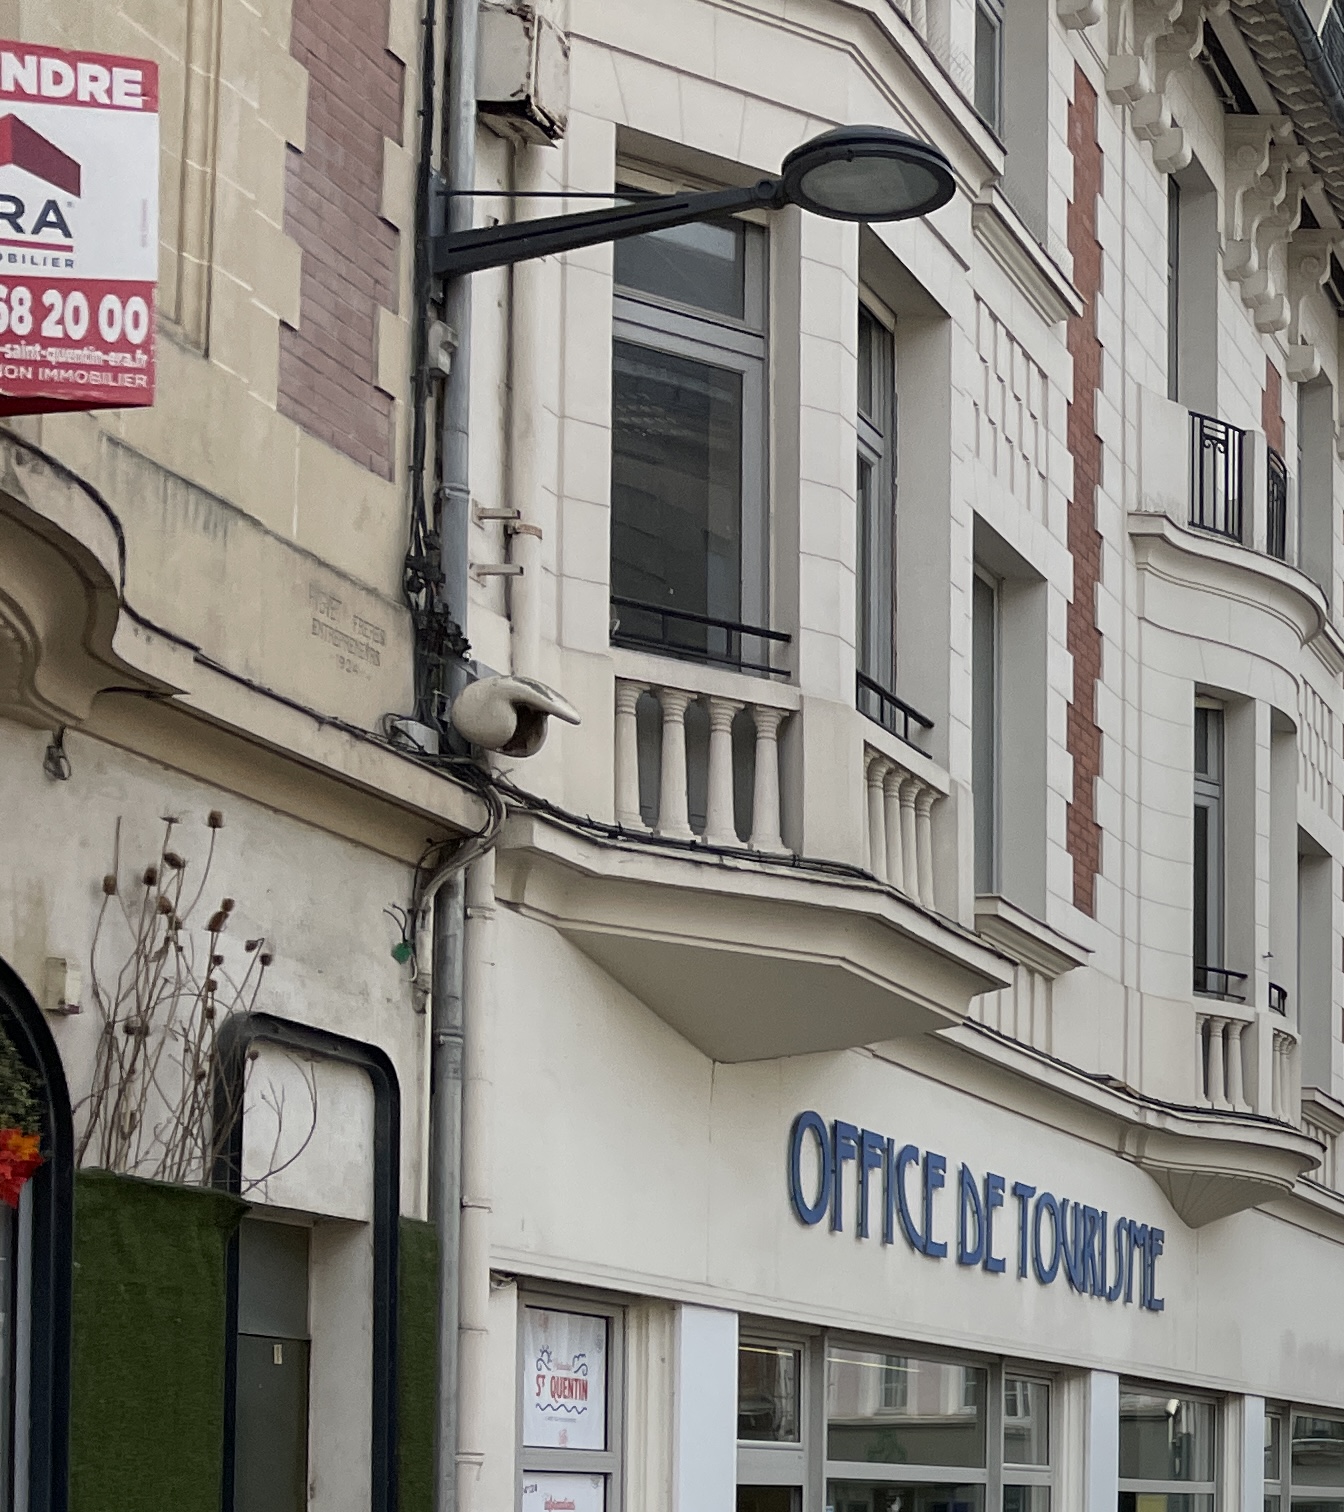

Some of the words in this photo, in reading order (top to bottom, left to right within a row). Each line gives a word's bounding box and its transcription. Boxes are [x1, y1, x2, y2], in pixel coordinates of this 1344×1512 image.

[0, 253, 74, 269] BILIER
[41, 289, 89, 341] 20
[98, 294, 149, 345] 00
[38, 367, 148, 388] IMMOBILIER
[790, 1110, 948, 1258] OFFICE
[957, 1162, 1006, 1274] DE
[1012, 1181, 1165, 1311] TOURISME
[550, 1375, 588, 1403] QUENTIN
